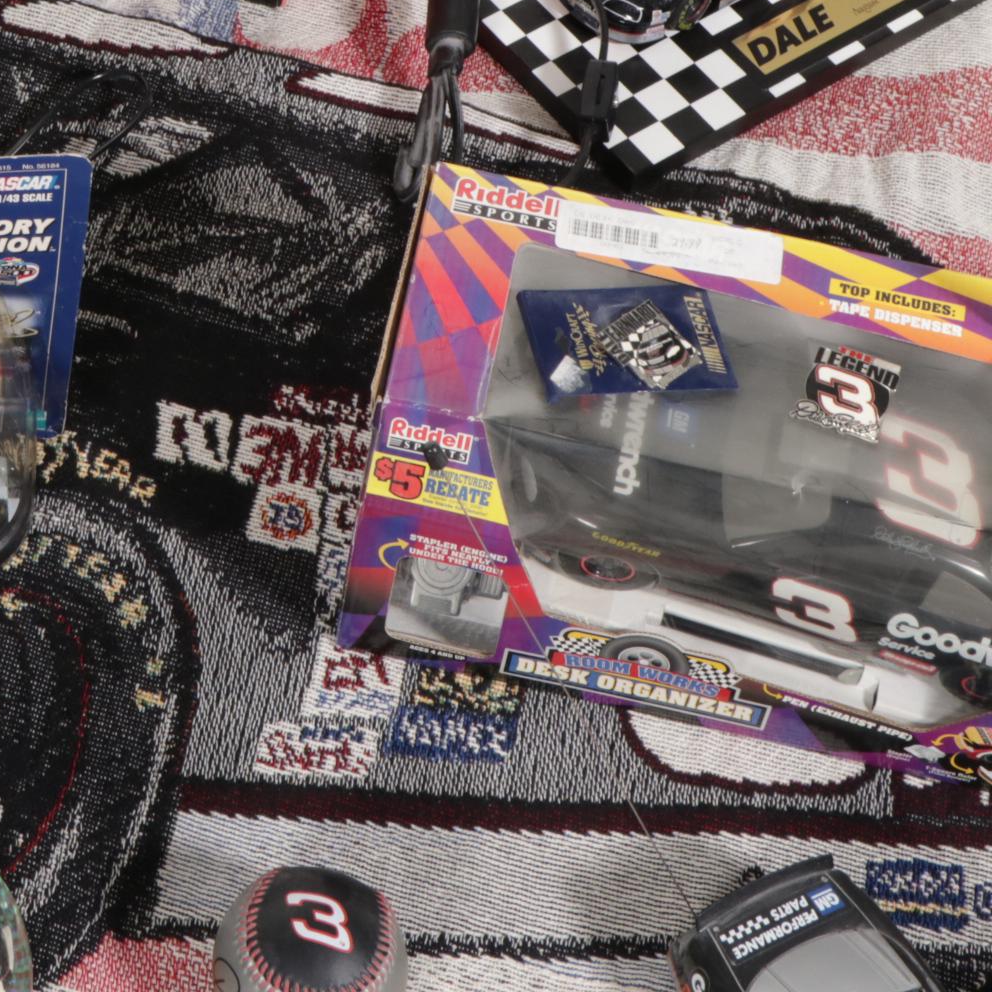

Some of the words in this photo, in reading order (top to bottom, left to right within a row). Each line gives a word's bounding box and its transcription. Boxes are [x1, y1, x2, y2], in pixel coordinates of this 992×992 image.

[747, 3, 835, 67] DALE
[22, 193, 53, 203] SCALE
[456, 178, 560, 218] Riddell
[473, 204, 557, 231] SPORTS
[828, 298, 870, 319] TAPE
[873, 307, 963, 338] DISPENSER
[839, 282, 870, 299] TOP
[874, 290, 957, 317] INCLUDES:
[684, 294, 717, 348] NASCAR
[814, 346, 900, 390] LEGEND
[815, 363, 880, 426] 3
[391, 418, 474, 451] Riddell
[403, 441, 467, 461] SPTS
[374, 455, 427, 500] $5
[424, 478, 492, 507] REBATE
[875, 413, 983, 550] 3
[409, 533, 458, 551] STAPLER
[409, 547, 446, 562] UNDER
[447, 556, 470, 567] THE
[424, 544, 450, 556] FITS
[771, 576, 858, 643] 3
[877, 637, 937, 661] Service
[515, 657, 590, 687] DESK
[595, 671, 756, 722] ORGANIZER
[563, 652, 632, 676] ROOM
[637, 664, 721, 698] WORKS
[781, 694, 810, 709] PEN
[810, 702, 878, 730] (EXHAUST
[877, 723, 913, 742] PIPE)
[770, 894, 809, 920] PARTS
[814, 888, 841, 912] GM
[285, 890, 354, 953] 3
[733, 909, 819, 960] PERFORMANCE
